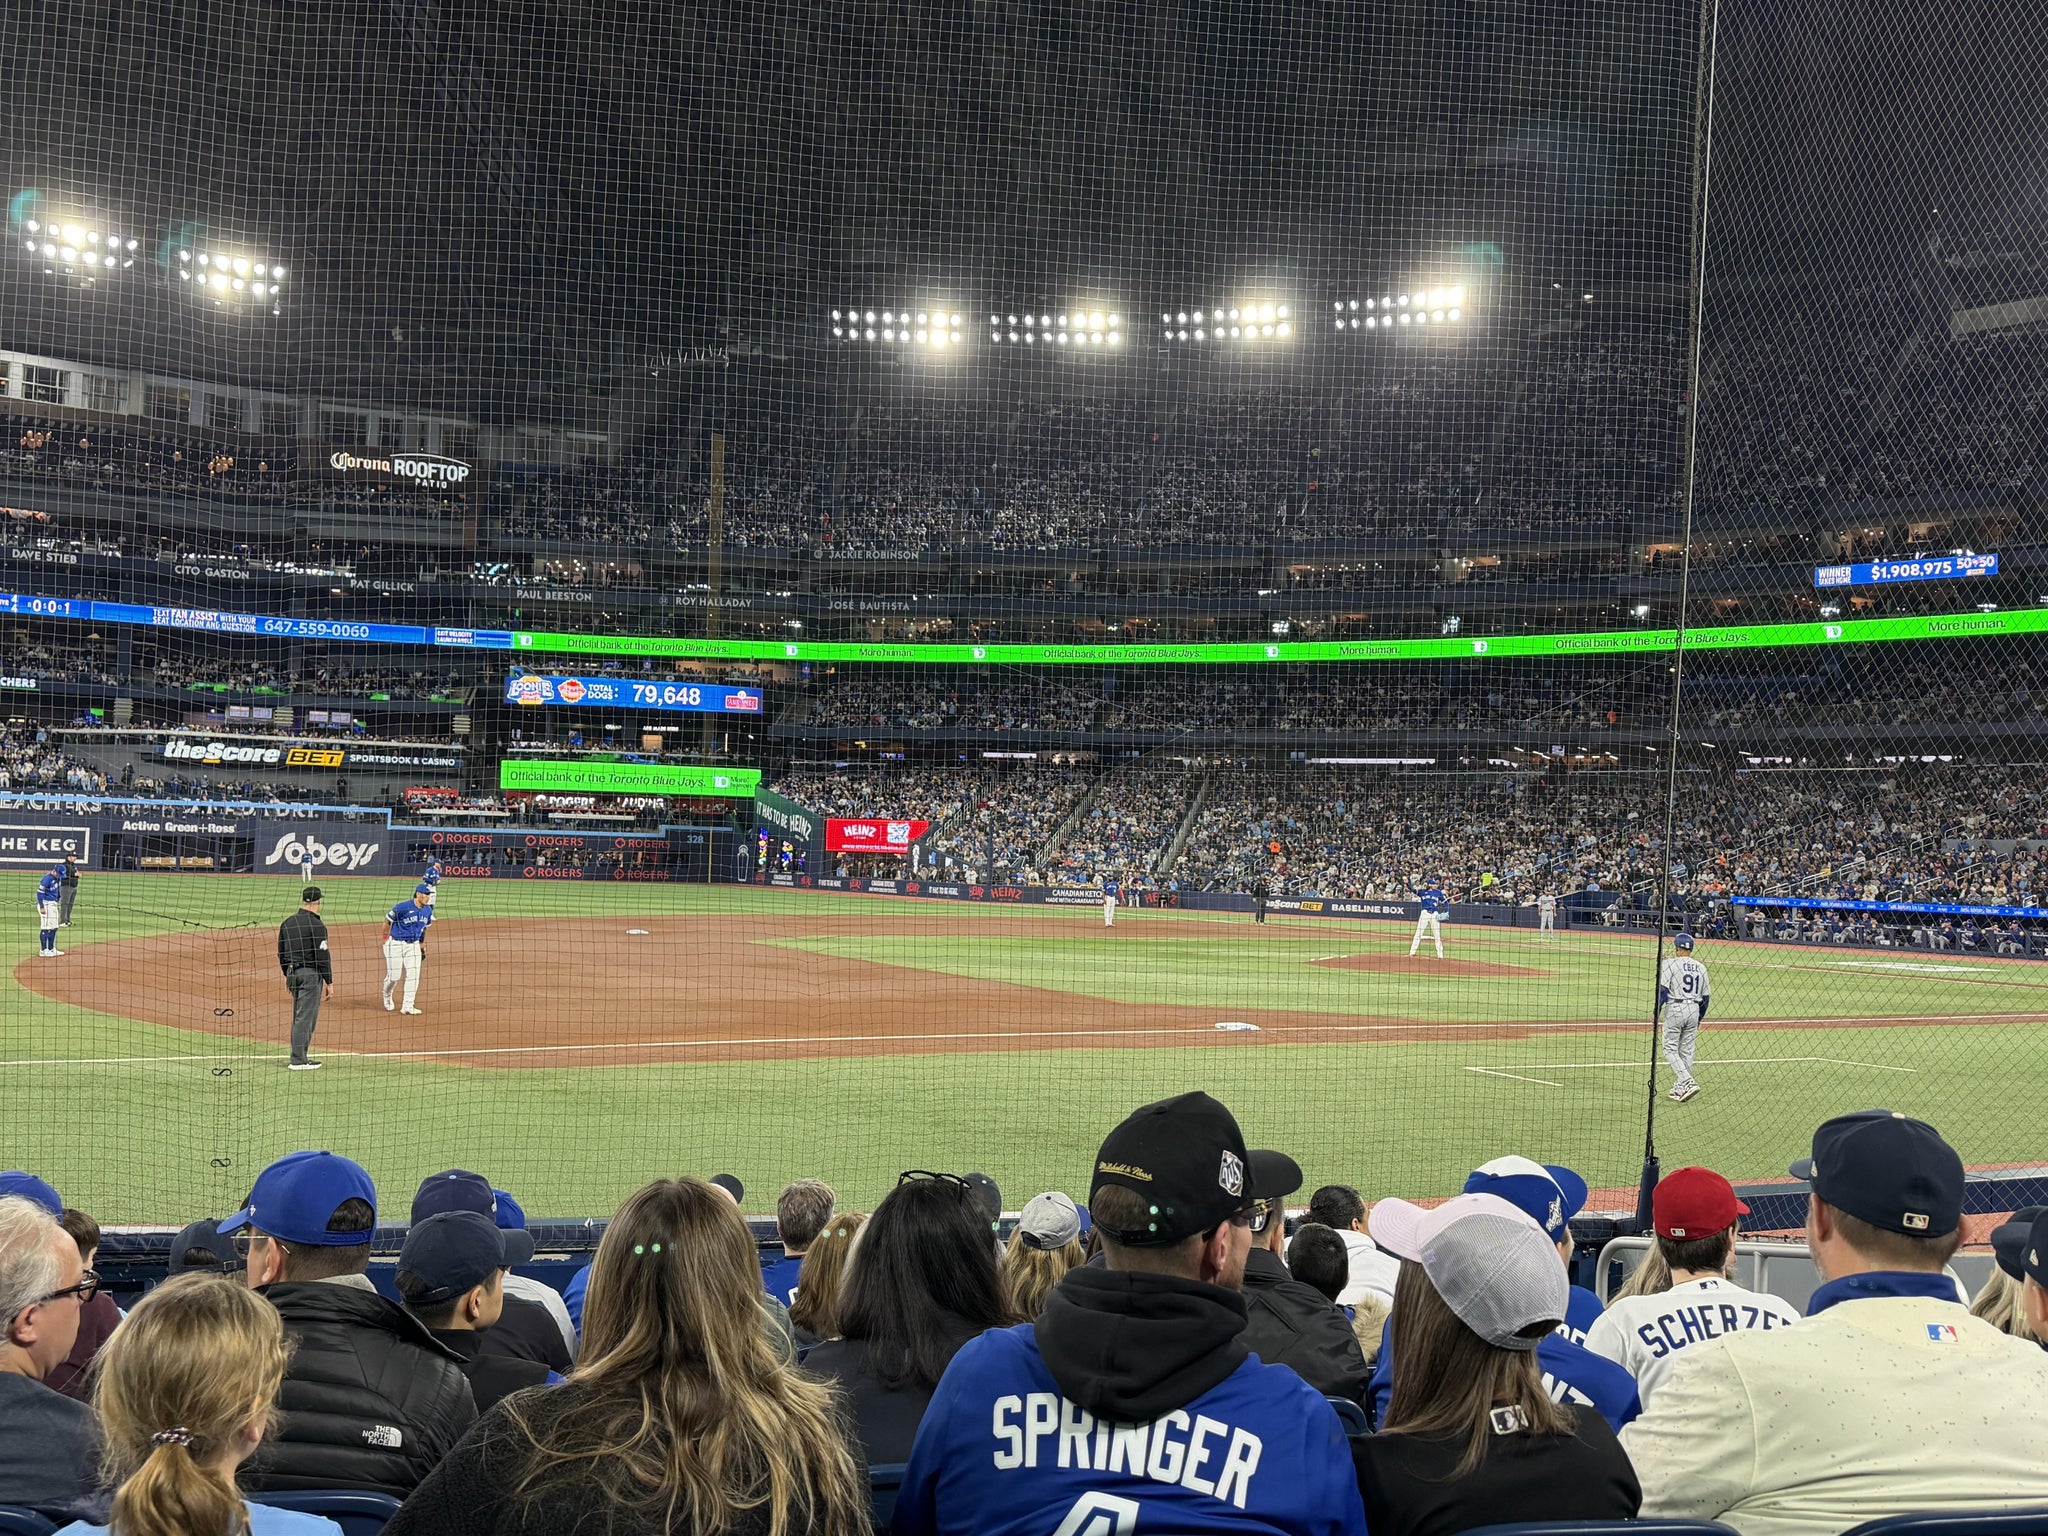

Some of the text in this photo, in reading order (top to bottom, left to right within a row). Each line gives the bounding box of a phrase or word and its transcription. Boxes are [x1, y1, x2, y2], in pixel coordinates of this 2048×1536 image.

[330, 452, 469, 482] Corona ROOFTOP
[415, 478, 447, 489] PATIO
[12, 549, 77, 564] DAVE STIEB
[829, 550, 919, 560] JACKIE ROBINSON
[175, 565, 250, 580] CITO GASTON
[1818, 567, 1852, 578] WINNER
[1871, 561, 1952, 580] $1,908,975
[350, 579, 414, 592] PAT GILLICK
[516, 589, 592, 601] PAUL BEESTON
[32, 599, 42, 613] 0
[47, 600, 57, 614] 0
[64, 602, 71, 615] 1
[675, 596, 752, 608] ROY HALLADAY
[860, 601, 910, 611] BAUTISTA
[171, 609, 188, 619] FAN
[189, 610, 219, 621] ASSIST
[238, 616, 257, 625] YOUR
[264, 619, 370, 638] 647-559-0060
[1928, 619, 2006, 632] More human.
[518, 634, 533, 646] TD
[567, 638, 599, 649] Official
[601, 639, 622, 650] bank
[624, 640, 633, 651] of
[634, 640, 650, 651] the
[651, 641, 684, 653] Toronto
[1555, 637, 1592, 649] Official
[1593, 637, 1619, 648] bank
[1621, 636, 1633, 647] of
[1634, 635, 1650, 646] the
[1693, 632, 1719, 644] Blue
[1721, 632, 1750, 645] Jays.
[1043, 649, 1074, 659] Official
[1075, 649, 1097, 659] bank
[1098, 649, 1108, 659] of
[1108, 649, 1123, 659] the
[1124, 649, 1156, 659] Toronto
[1158, 648, 1177, 658] Blue
[1339, 645, 1400, 656] More human.
[588, 683, 613, 692] TOTAL
[632, 684, 700, 707] 79,648
[163, 741, 342, 765] theScore BET
[350, 753, 455, 767] SPORTSBOOK & CASINO
[510, 770, 706, 788] Official bank of the Toronto Blue Jays.
[713, 775, 729, 788] TD
[123, 820, 237, 834] Active Green+Ross
[757, 801, 762, 816] IT
[762, 803, 773, 821] HAS
[773, 809, 780, 825] TO
[781, 813, 788, 829] BE
[789, 814, 812, 841] HEINZ
[843, 824, 877, 837] HEINZ
[1, 837, 77, 851] HE KEG
[447, 834, 493, 844] ROGERS
[539, 836, 584, 847] ROGERS
[628, 838, 671, 849] ROGERS
[687, 835, 704, 844] 328
[266, 832, 379, 870] Sobeys
[445, 866, 491, 876] ROGERS
[538, 868, 583, 878] ROGERS
[628, 870, 670, 880] ROGERS
[991, 886, 1022, 899] HEINZ
[1052, 889, 1084, 897] CANADIAN
[1302, 902, 1322, 911] BET
[1331, 903, 1405, 915] BASELINE BOX
[1683, 974, 1700, 994] 91
[1637, 1303, 1791, 1358] SCHERZE
[362, 1430, 390, 1439] NORTH
[375, 1425, 390, 1433] THE
[367, 1438, 390, 1446] FACE
[993, 1392, 1263, 1510] SPRINGER
